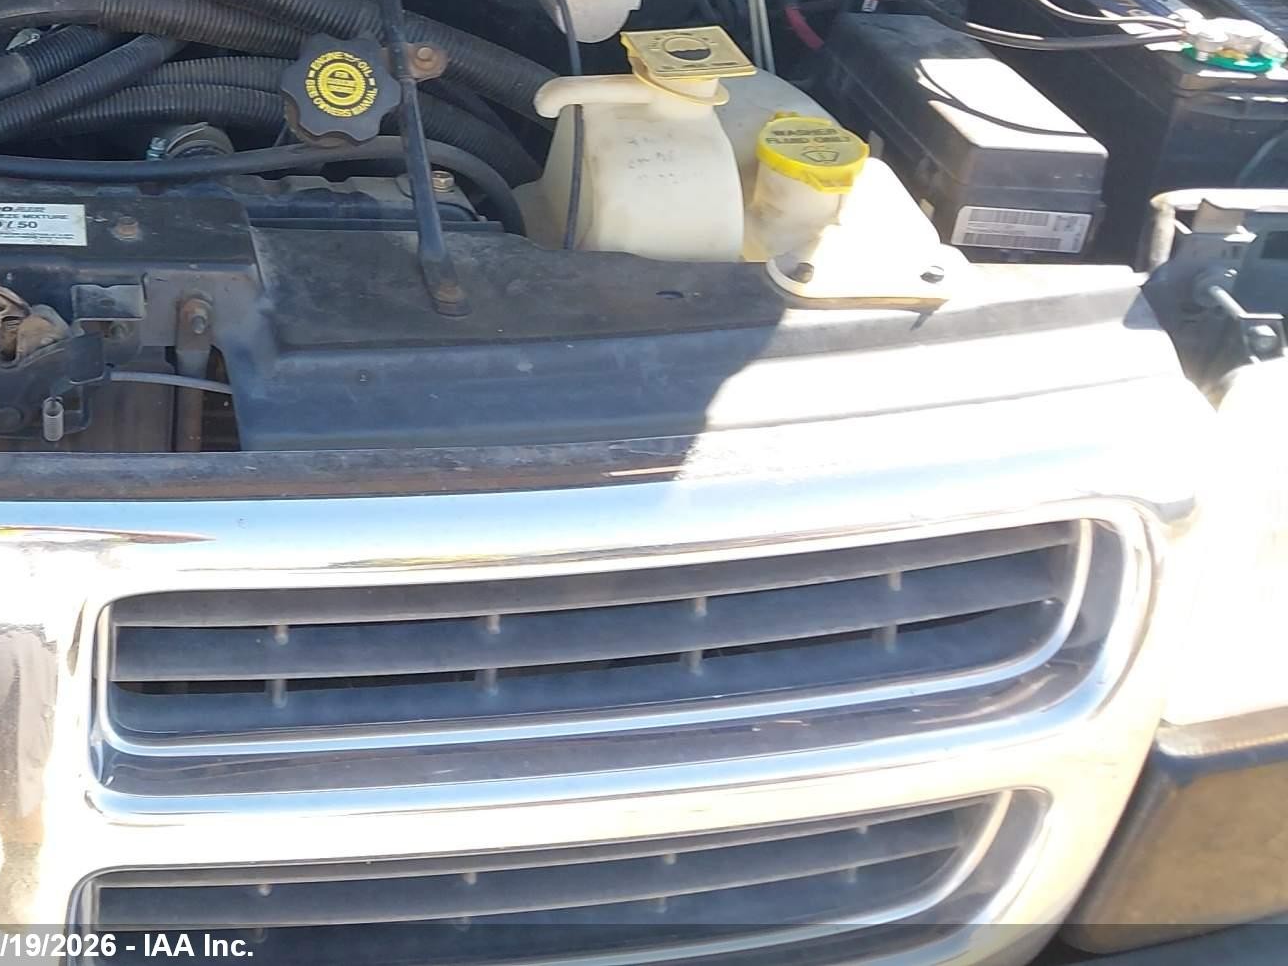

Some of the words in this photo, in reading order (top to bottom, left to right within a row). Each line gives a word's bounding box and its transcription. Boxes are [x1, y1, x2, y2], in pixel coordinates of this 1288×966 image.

[357, 61, 373, 78] OIL
[772, 128, 837, 136] WASHER
[17, 221, 38, 229] 50
